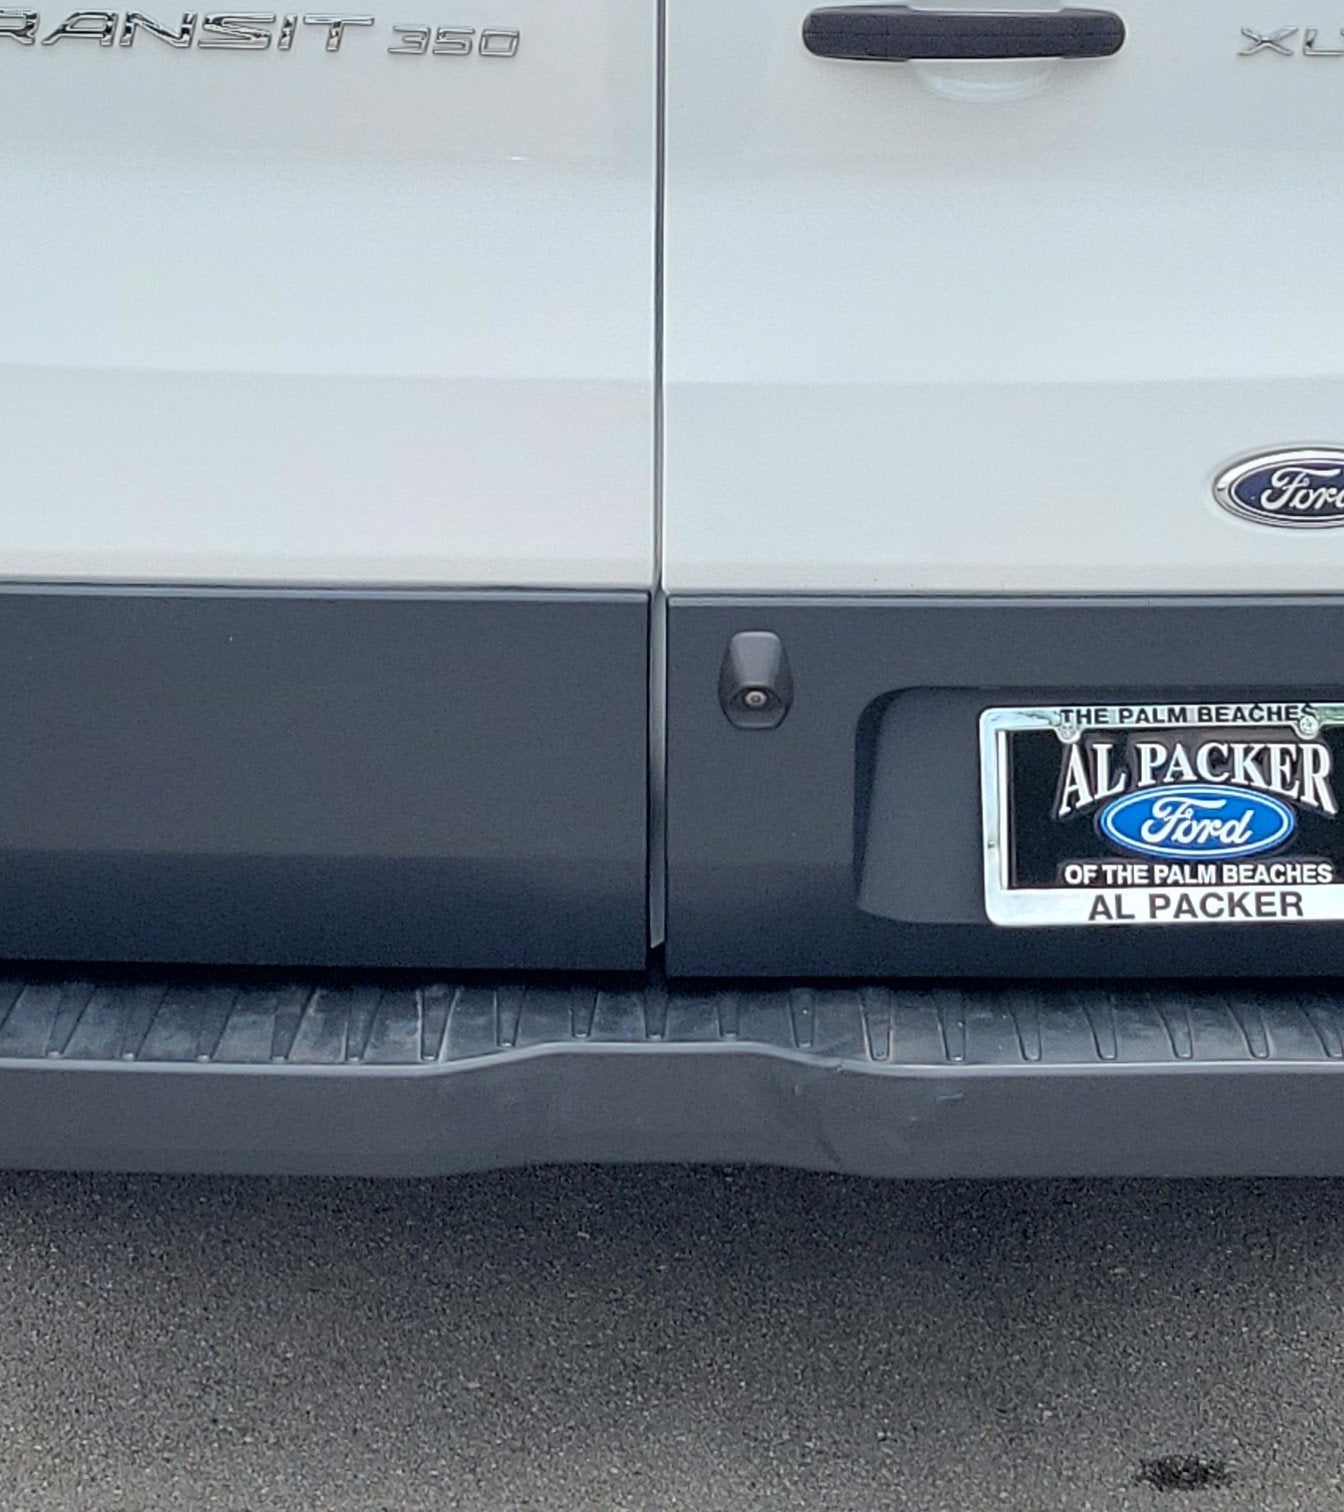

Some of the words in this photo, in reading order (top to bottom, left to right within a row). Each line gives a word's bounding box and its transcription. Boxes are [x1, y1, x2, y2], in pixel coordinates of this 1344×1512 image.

[387, 24, 521, 57] 350
[1060, 708, 1109, 725] THE
[1118, 706, 1189, 724] PALM
[1197, 703, 1317, 722] BEACHES
[1058, 742, 1127, 816] AL
[1134, 741, 1339, 816] PACKER
[1140, 796, 1256, 845] Ford
[1064, 864, 1098, 885] OF
[1101, 864, 1149, 885] THE
[1153, 864, 1217, 885] PALM
[1221, 863, 1334, 885] BEACHES
[1087, 894, 1136, 921] AL
[1148, 891, 1305, 920] PACKER
